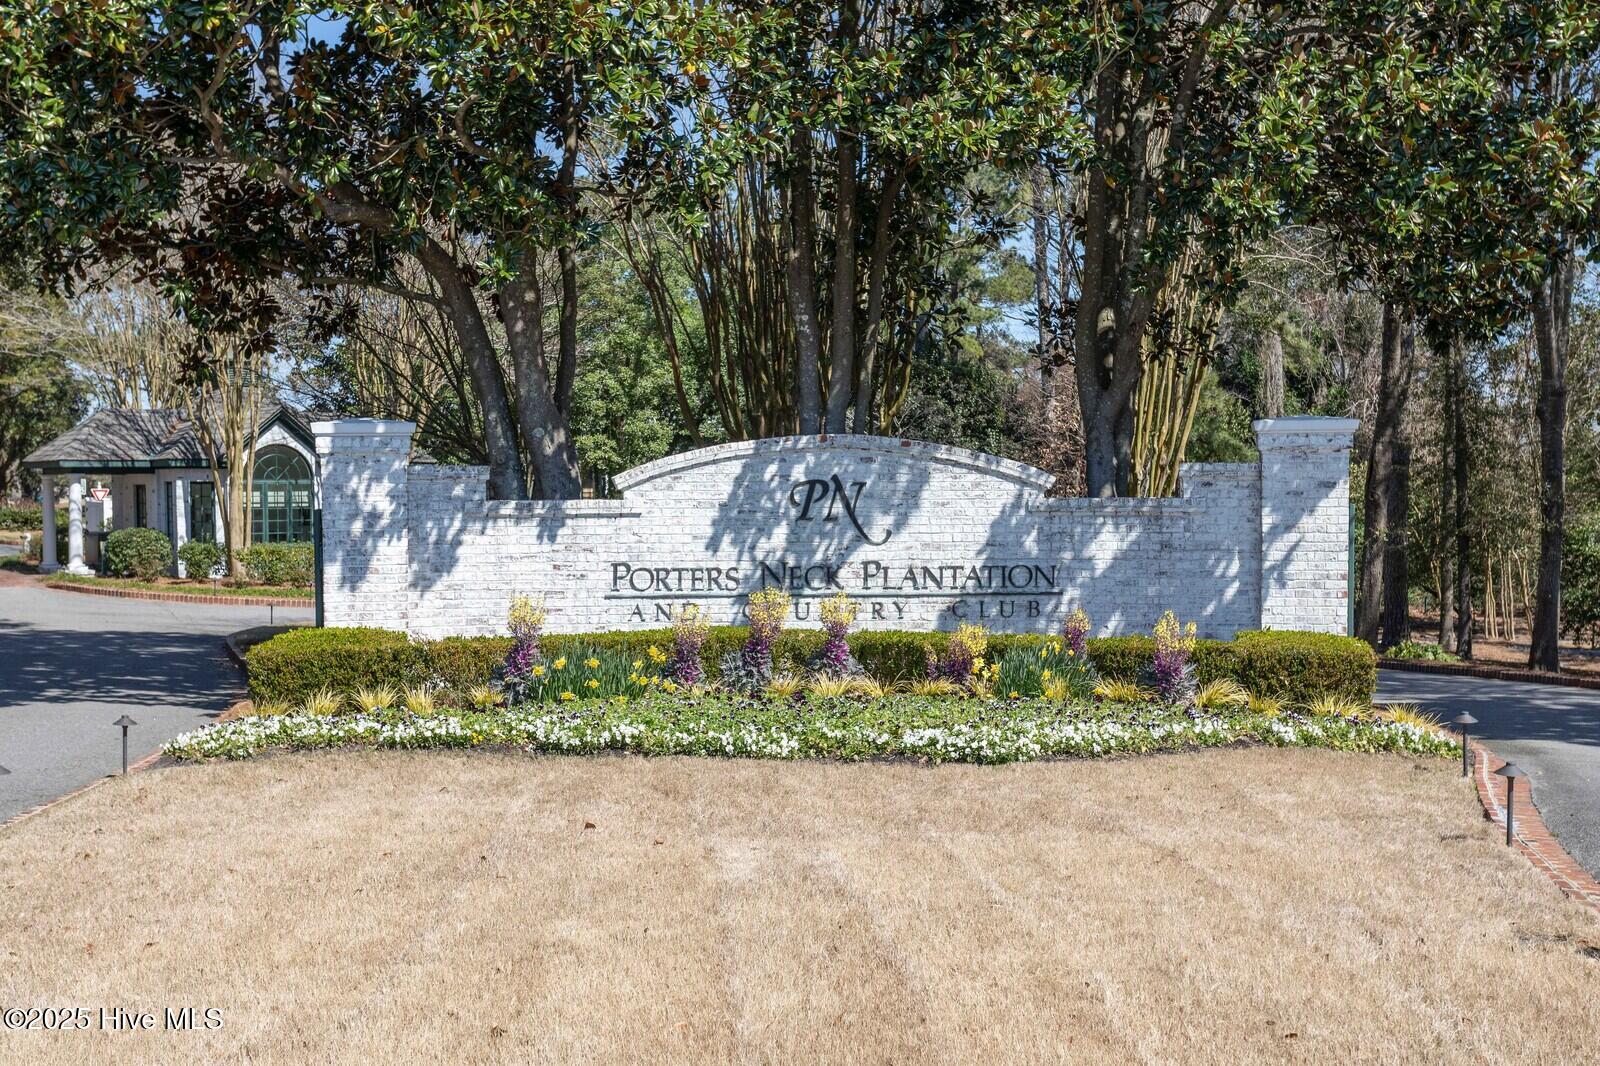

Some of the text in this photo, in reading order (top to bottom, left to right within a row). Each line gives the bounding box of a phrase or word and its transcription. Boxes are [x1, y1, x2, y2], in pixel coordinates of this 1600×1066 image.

[789, 473, 892, 546] PN
[610, 560, 1057, 592] PORTERS NECK PLANTATION
[952, 599, 1041, 618] CLUB
